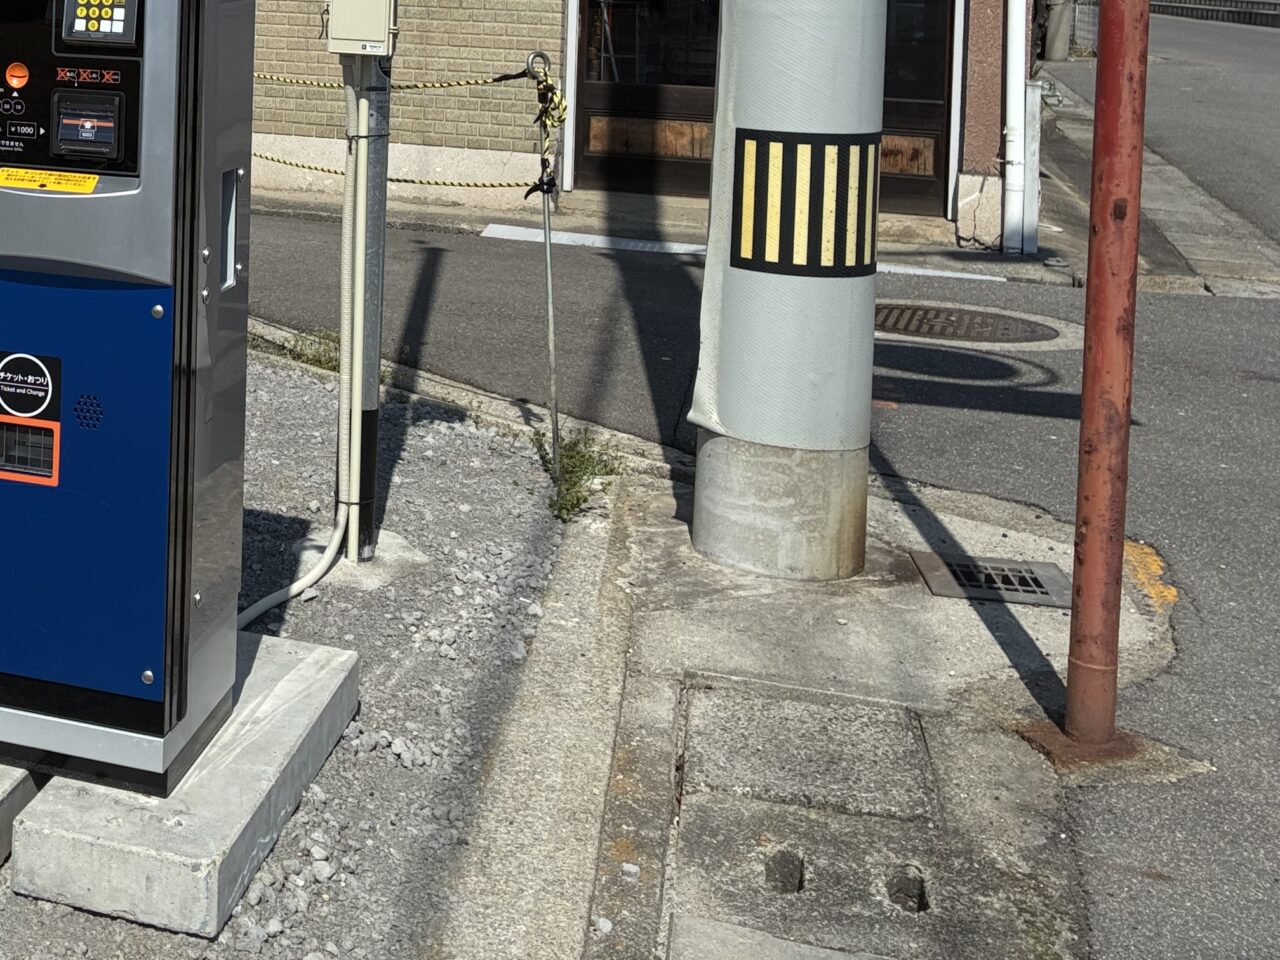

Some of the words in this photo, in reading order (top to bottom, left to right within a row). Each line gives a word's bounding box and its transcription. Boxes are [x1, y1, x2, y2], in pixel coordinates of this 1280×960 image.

[0, 371, 48, 386] チケット・おつり
[0, 385, 16, 393] Ticket
[27, 389, 46, 398] Change
